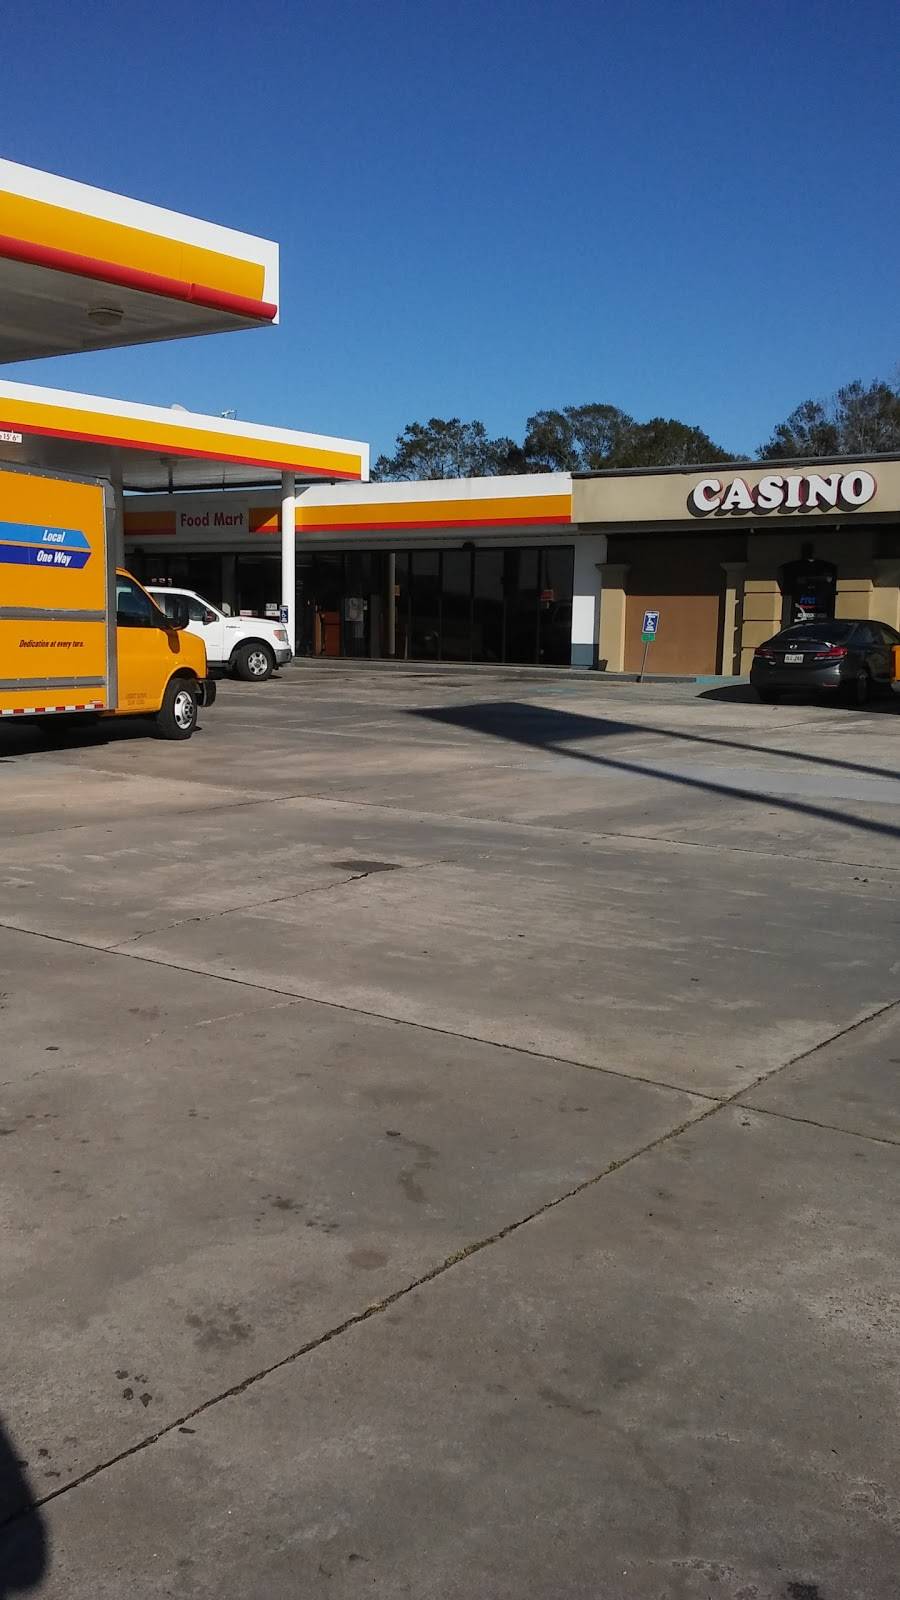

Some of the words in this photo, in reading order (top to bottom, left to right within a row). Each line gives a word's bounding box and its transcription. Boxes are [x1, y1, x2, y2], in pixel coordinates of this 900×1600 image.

[688, 470, 877, 517] CASINO
[180, 511, 210, 527] Food
[214, 511, 244, 526] Mart
[42, 529, 66, 543] Local
[36, 550, 53, 562] One
[54, 552, 72, 567] Way
[19, 639, 49, 648] Dedication
[57, 641, 72, 649] every
